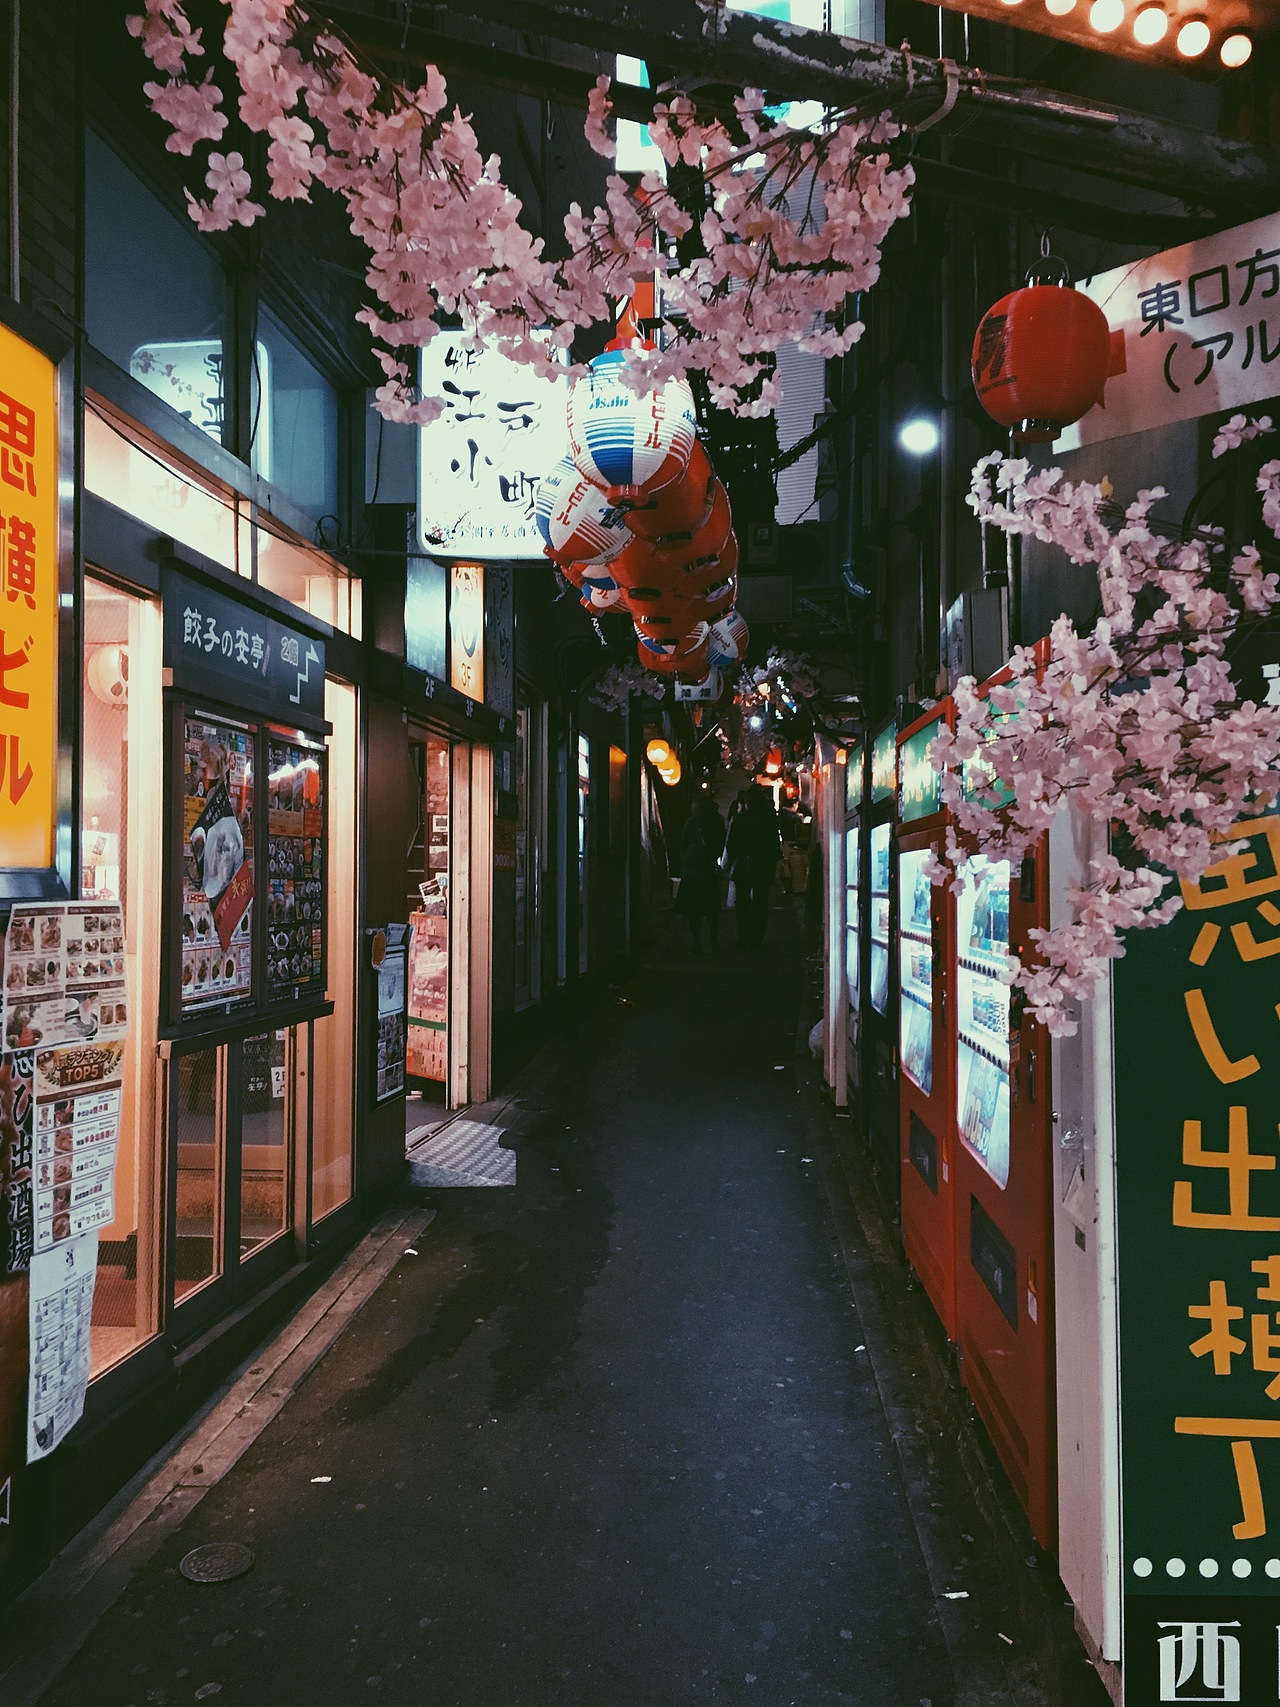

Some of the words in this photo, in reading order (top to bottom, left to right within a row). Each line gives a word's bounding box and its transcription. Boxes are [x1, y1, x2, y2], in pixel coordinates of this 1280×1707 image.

[1137, 248, 1280, 338] 東口方
[588, 394, 630, 411] Asahi
[183, 606, 265, 669] 餃子の安亭
[424, 676, 435, 699] 2F
[461, 662, 472, 689] 3F
[66, 1064, 99, 1082] TOP5
